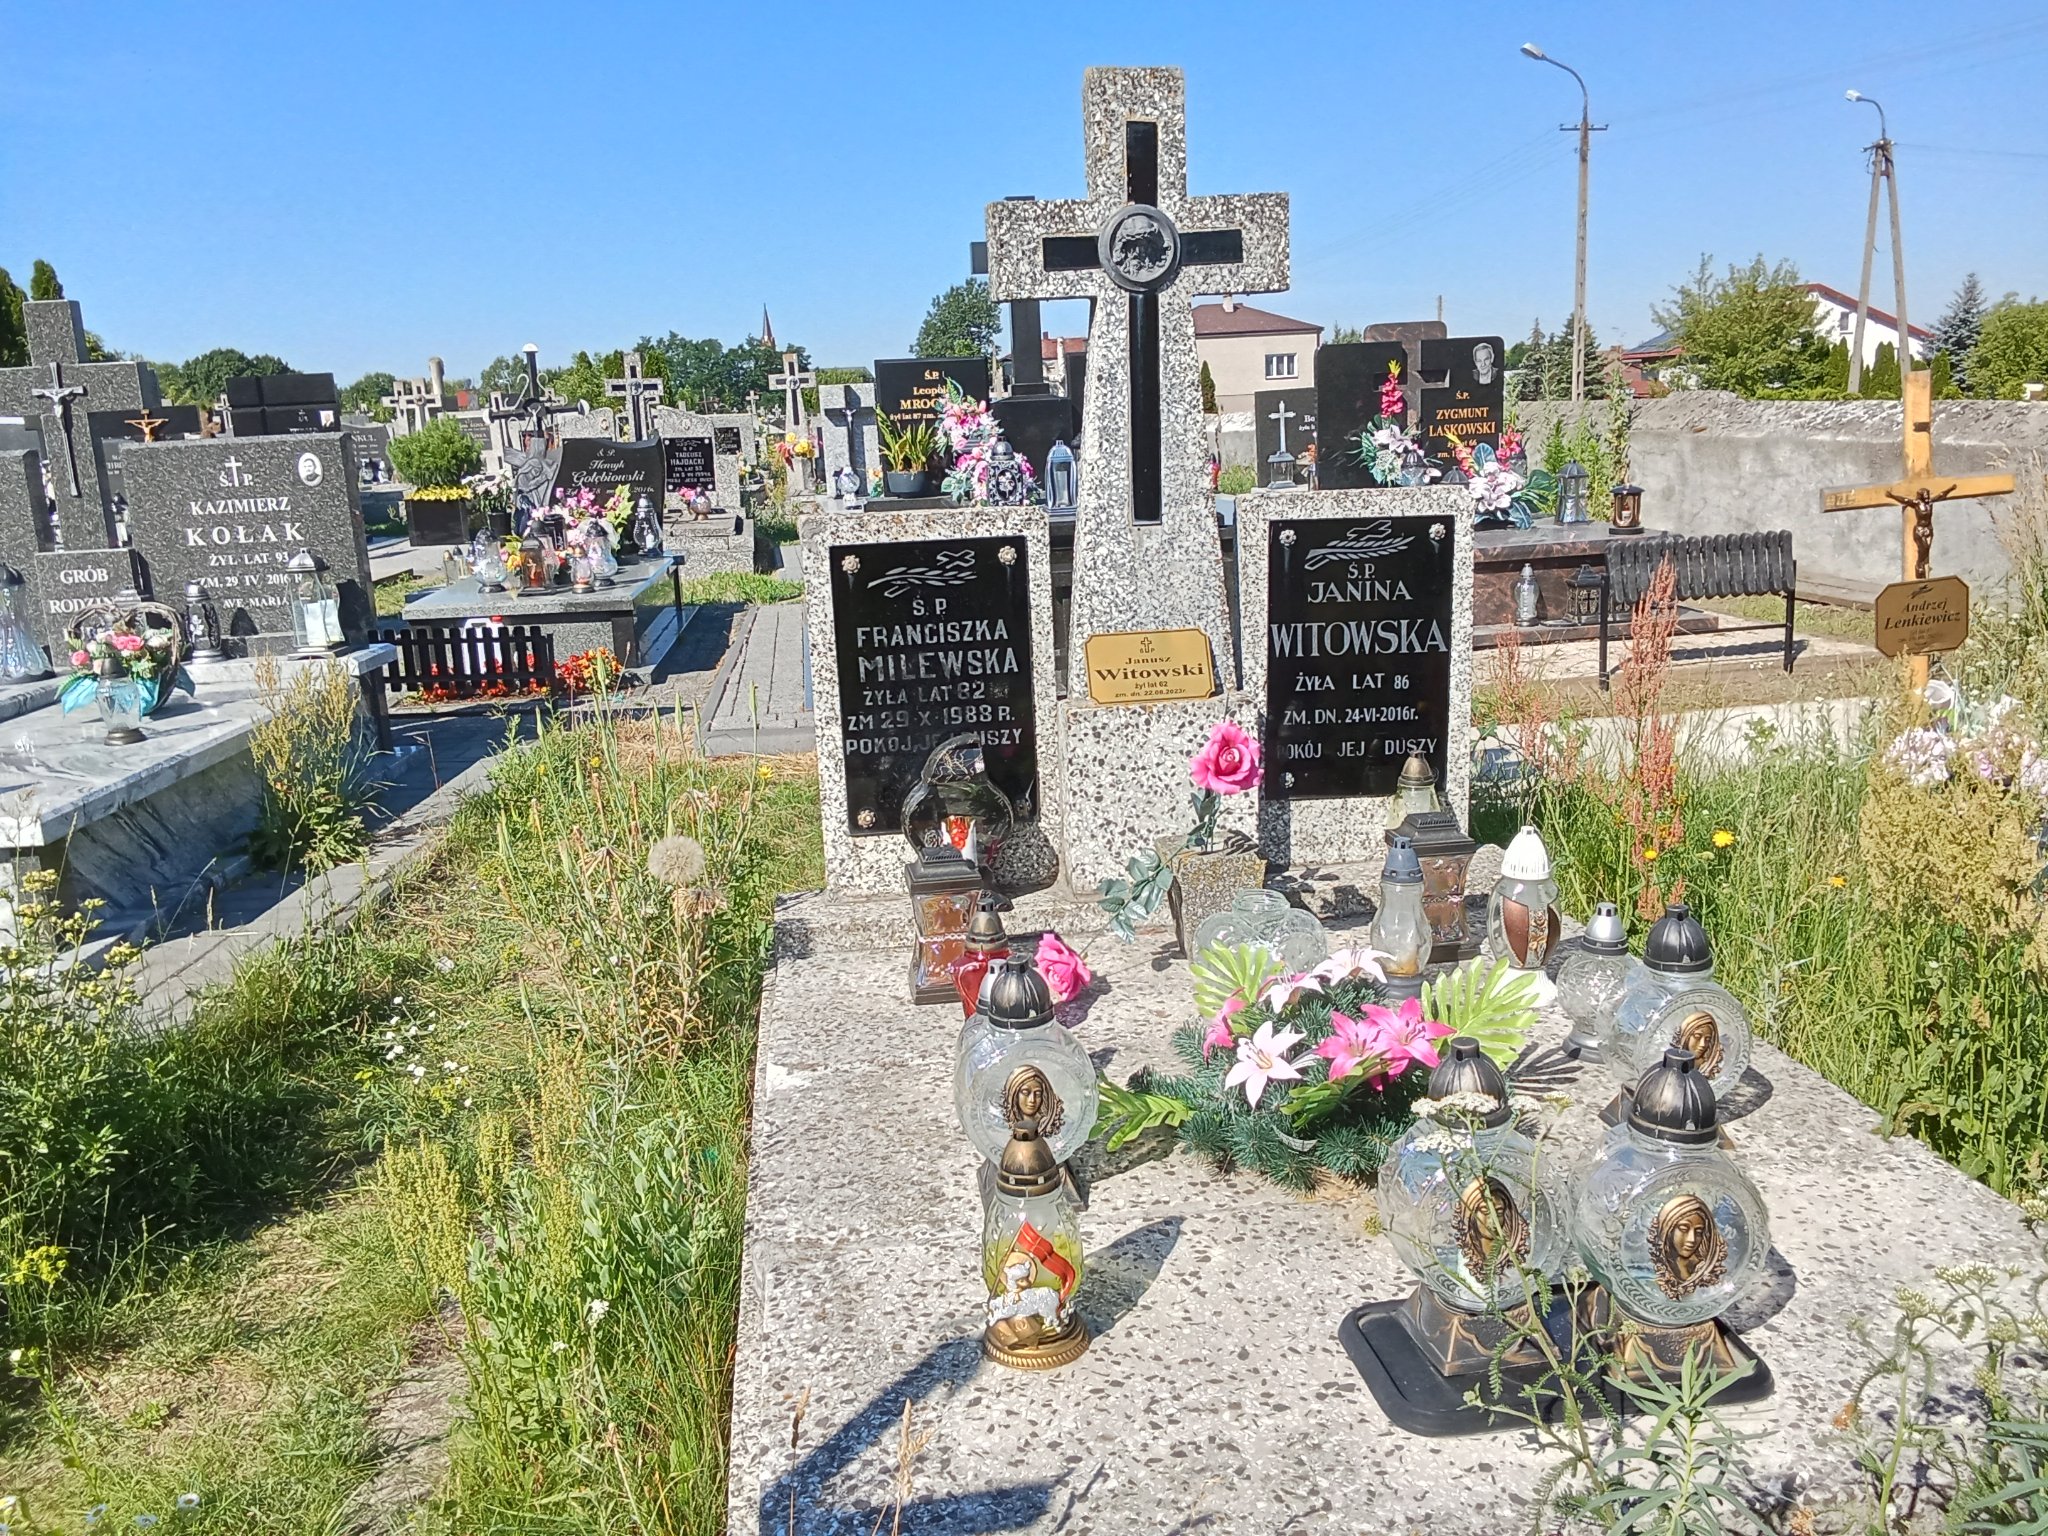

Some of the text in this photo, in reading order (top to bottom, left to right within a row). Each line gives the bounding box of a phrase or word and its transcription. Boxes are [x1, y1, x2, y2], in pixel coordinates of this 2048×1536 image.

[912, 385, 949, 397] Leopol
[1435, 407, 1489, 420] ZYGMUNT
[571, 470, 646, 487] Gołębiowski
[189, 496, 292, 516] KAZIMIERZ
[184, 522, 305, 547] KOŁAK
[243, 552, 270, 565] LAT
[275, 551, 289, 563] 93
[60, 565, 109, 585] GRÓB
[225, 576, 239, 587] 29
[1307, 580, 1414, 604] JANINA
[222, 598, 244, 609] AVE
[1903, 599, 1948, 613] Andrzej
[1885, 610, 1961, 630] Lenkiewicz
[856, 618, 1010, 649] FRANCISZKA
[1270, 618, 1449, 658] WITOWSKA
[857, 647, 1020, 683] MILEWSKA
[1125, 656, 1172, 665] Janusz
[1095, 662, 1205, 681] Witowski
[1294, 672, 1410, 692] ŻYŁA LAT 86
[862, 685, 909, 707] ŻYŁA
[917, 685, 953, 704] LAT
[956, 680, 987, 700] 82
[942, 704, 993, 725] 1988
[998, 705, 1017, 722] R.
[1282, 705, 1420, 726] ZM. DN. 24-VI-2016r.
[1336, 740, 1366, 757] JEJ
[1384, 737, 1438, 756] DUSZY
